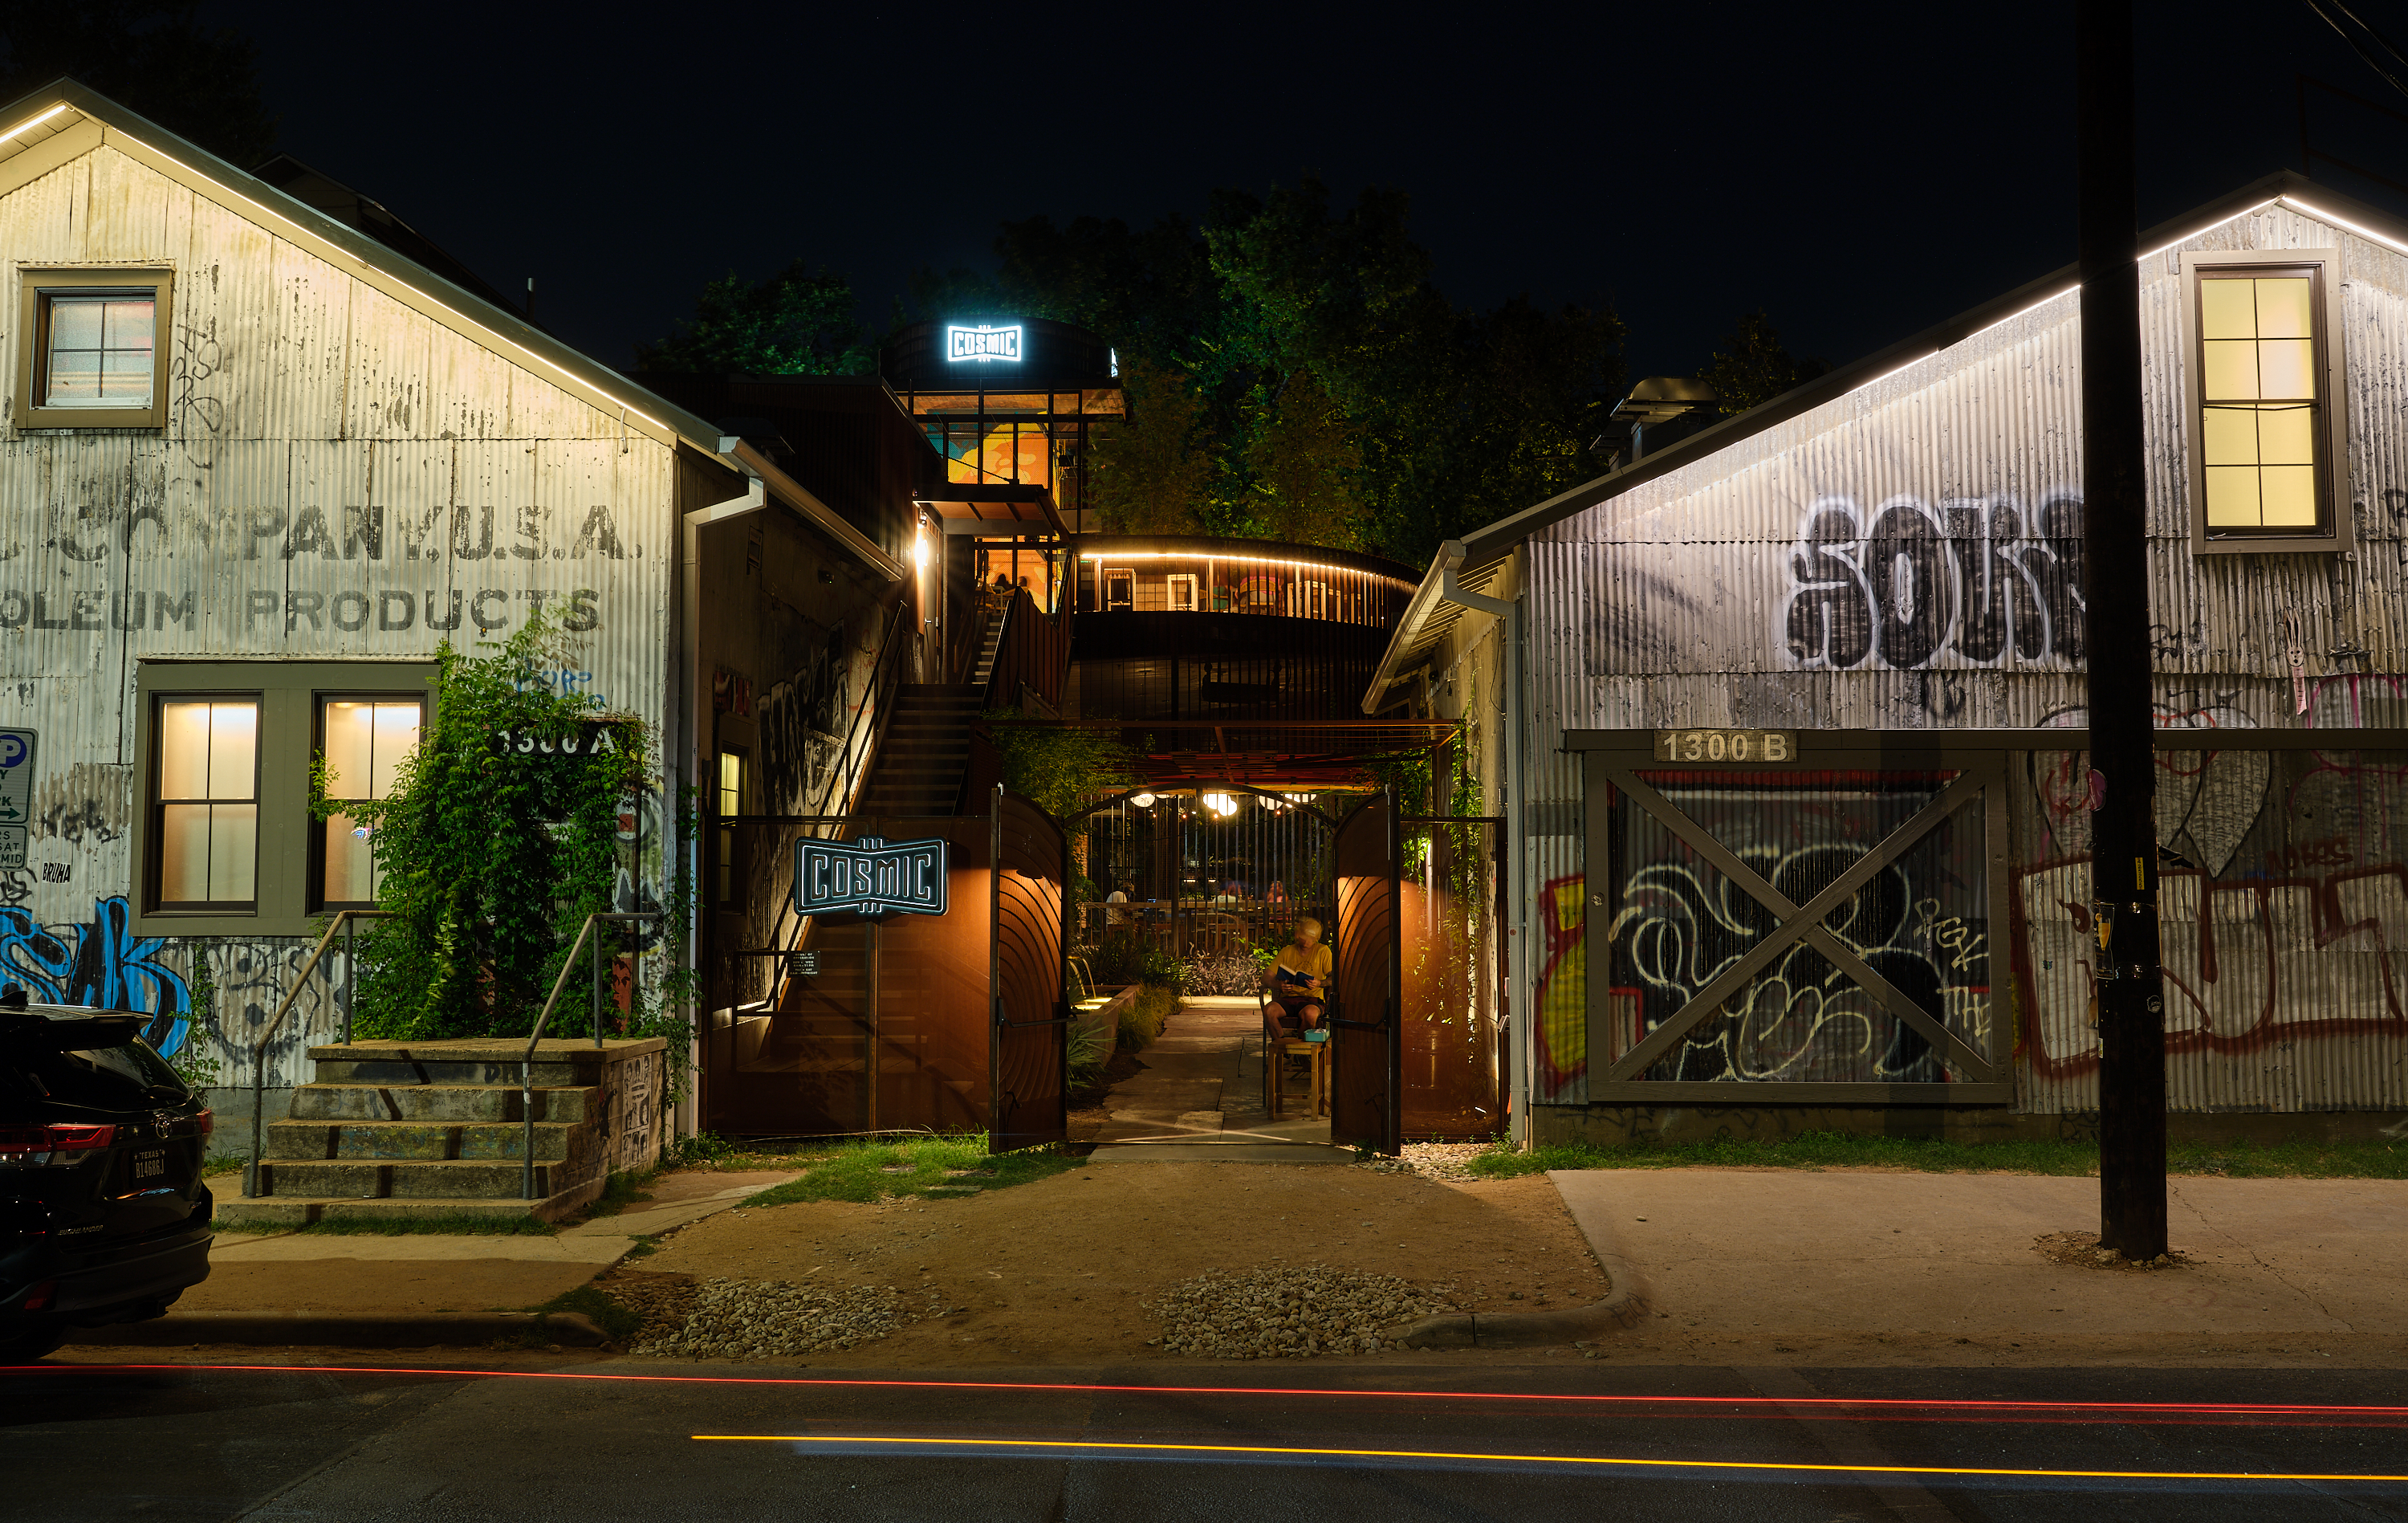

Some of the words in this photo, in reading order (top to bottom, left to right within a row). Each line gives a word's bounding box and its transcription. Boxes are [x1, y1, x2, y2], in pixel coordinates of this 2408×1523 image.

[954, 331, 1015, 356] COSMIC
[246, 588, 600, 632] PRODUCTS
[590, 727, 616, 754] A
[1664, 733, 1748, 761] 1300
[1764, 734, 1788, 761] B
[43, 861, 71, 884] BRUHA
[811, 853, 931, 901] COSMIC
[140, 1150, 159, 1159] TEXAS
